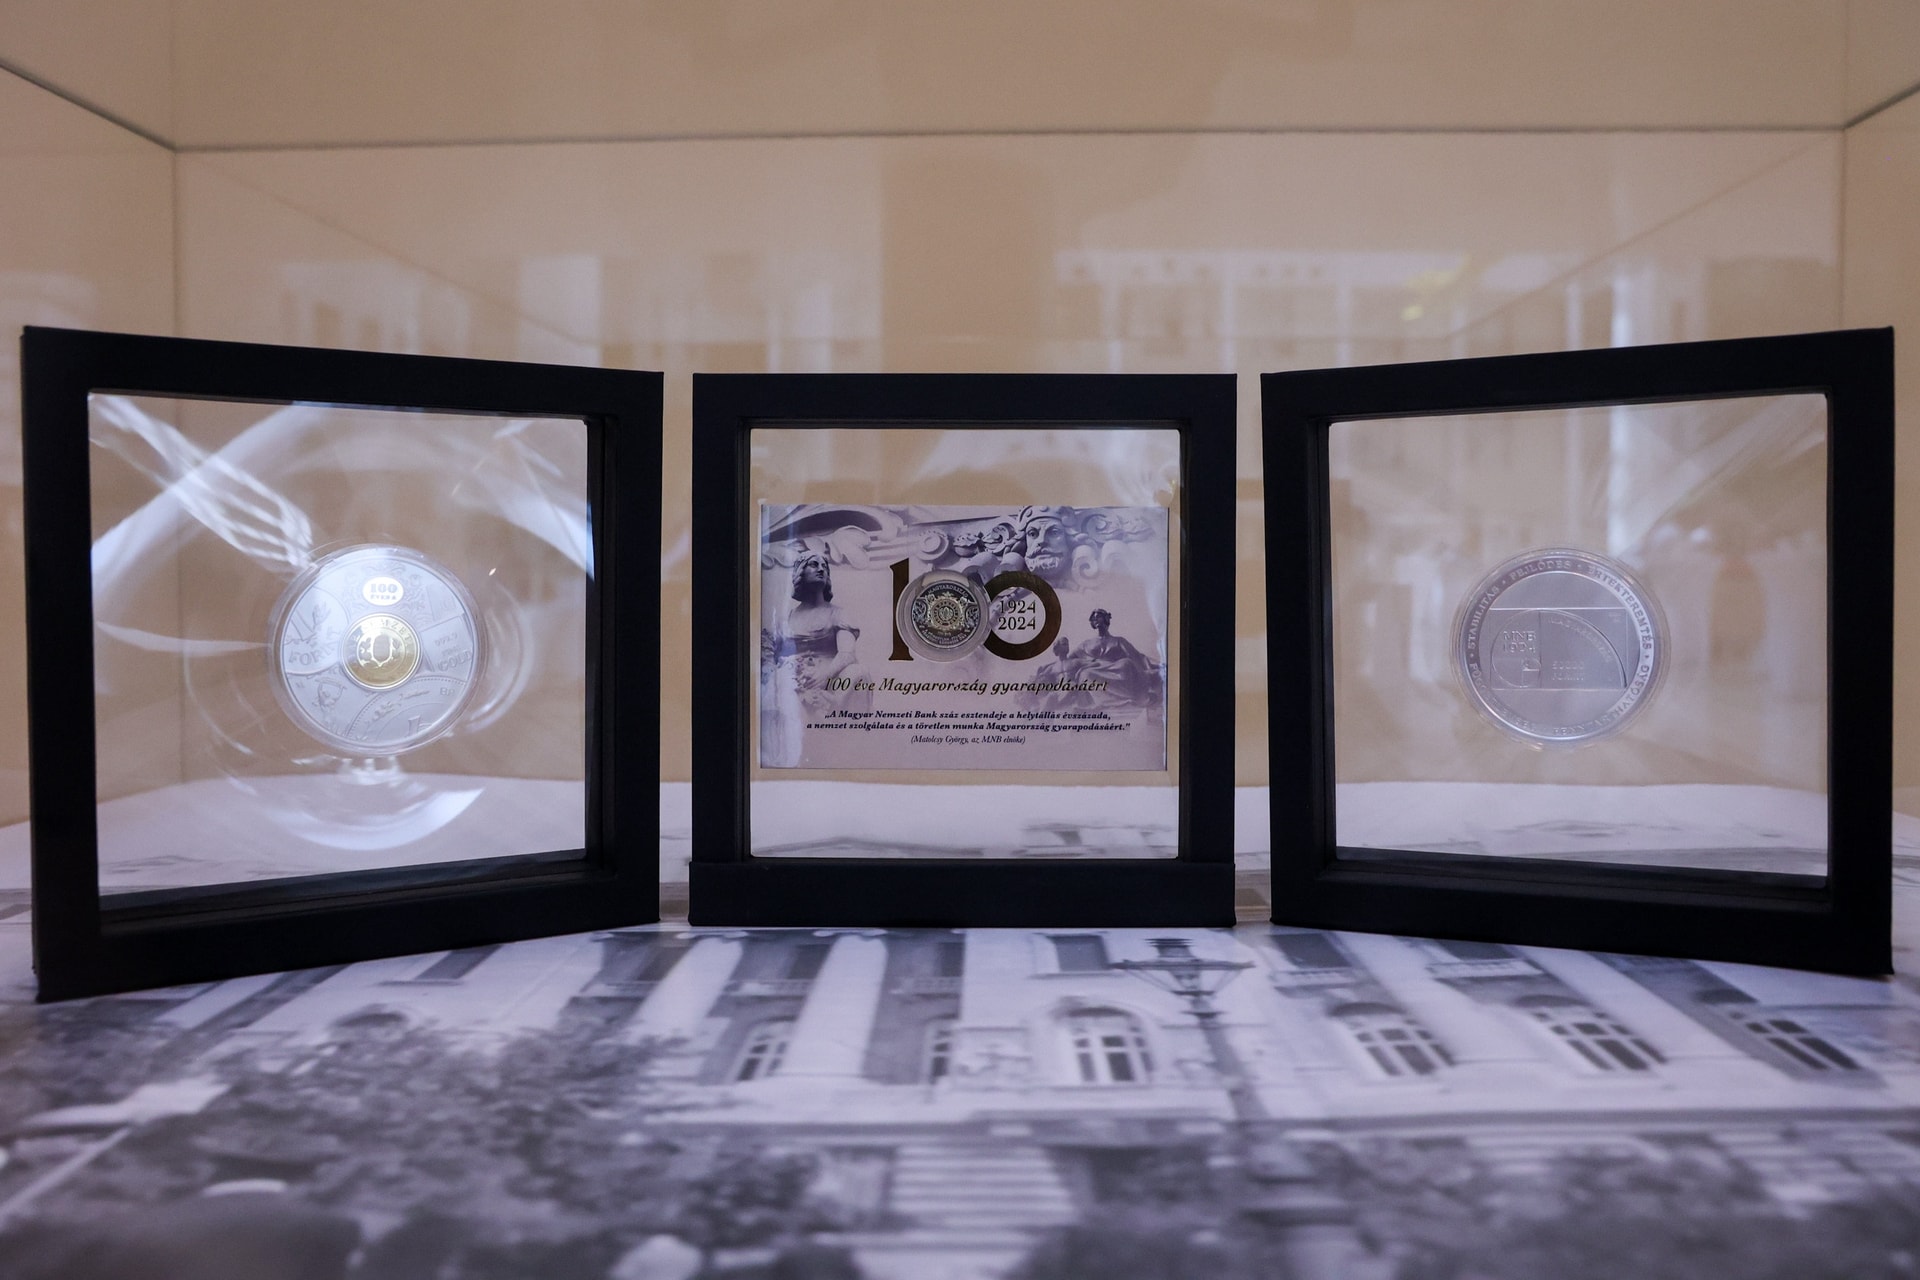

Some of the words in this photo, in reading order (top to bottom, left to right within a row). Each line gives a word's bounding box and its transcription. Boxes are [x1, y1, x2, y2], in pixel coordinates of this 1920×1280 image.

[999, 600, 1036, 614] 1924
[998, 616, 1036, 630] 2024
[1503, 630, 1536, 641] MNB
[824, 677, 851, 691] 100
[854, 679, 876, 691] éve
[879, 677, 988, 695] Magyarország
[991, 677, 1108, 695] gyarapodásáért
[838, 710, 874, 720] Magyar
[875, 710, 912, 718] Nemzeti
[914, 710, 938, 719] Bank
[939, 710, 958, 719] száz
[961, 711, 1007, 721] esztendeje
[1016, 711, 1061, 721] helytállás
[1062, 711, 1111, 721] évszázada,
[849, 721, 894, 731] szolgálata
[895, 721, 906, 730] és
[915, 721, 951, 730] töretlen
[952, 722, 985, 730] munka
[986, 722, 1050, 732] Magyarország
[910, 734, 943, 744] (Matolcsy
[945, 734, 969, 744] György,
[981, 735, 1002, 744] MNB
[1003, 735, 1026, 744] elnöke)
